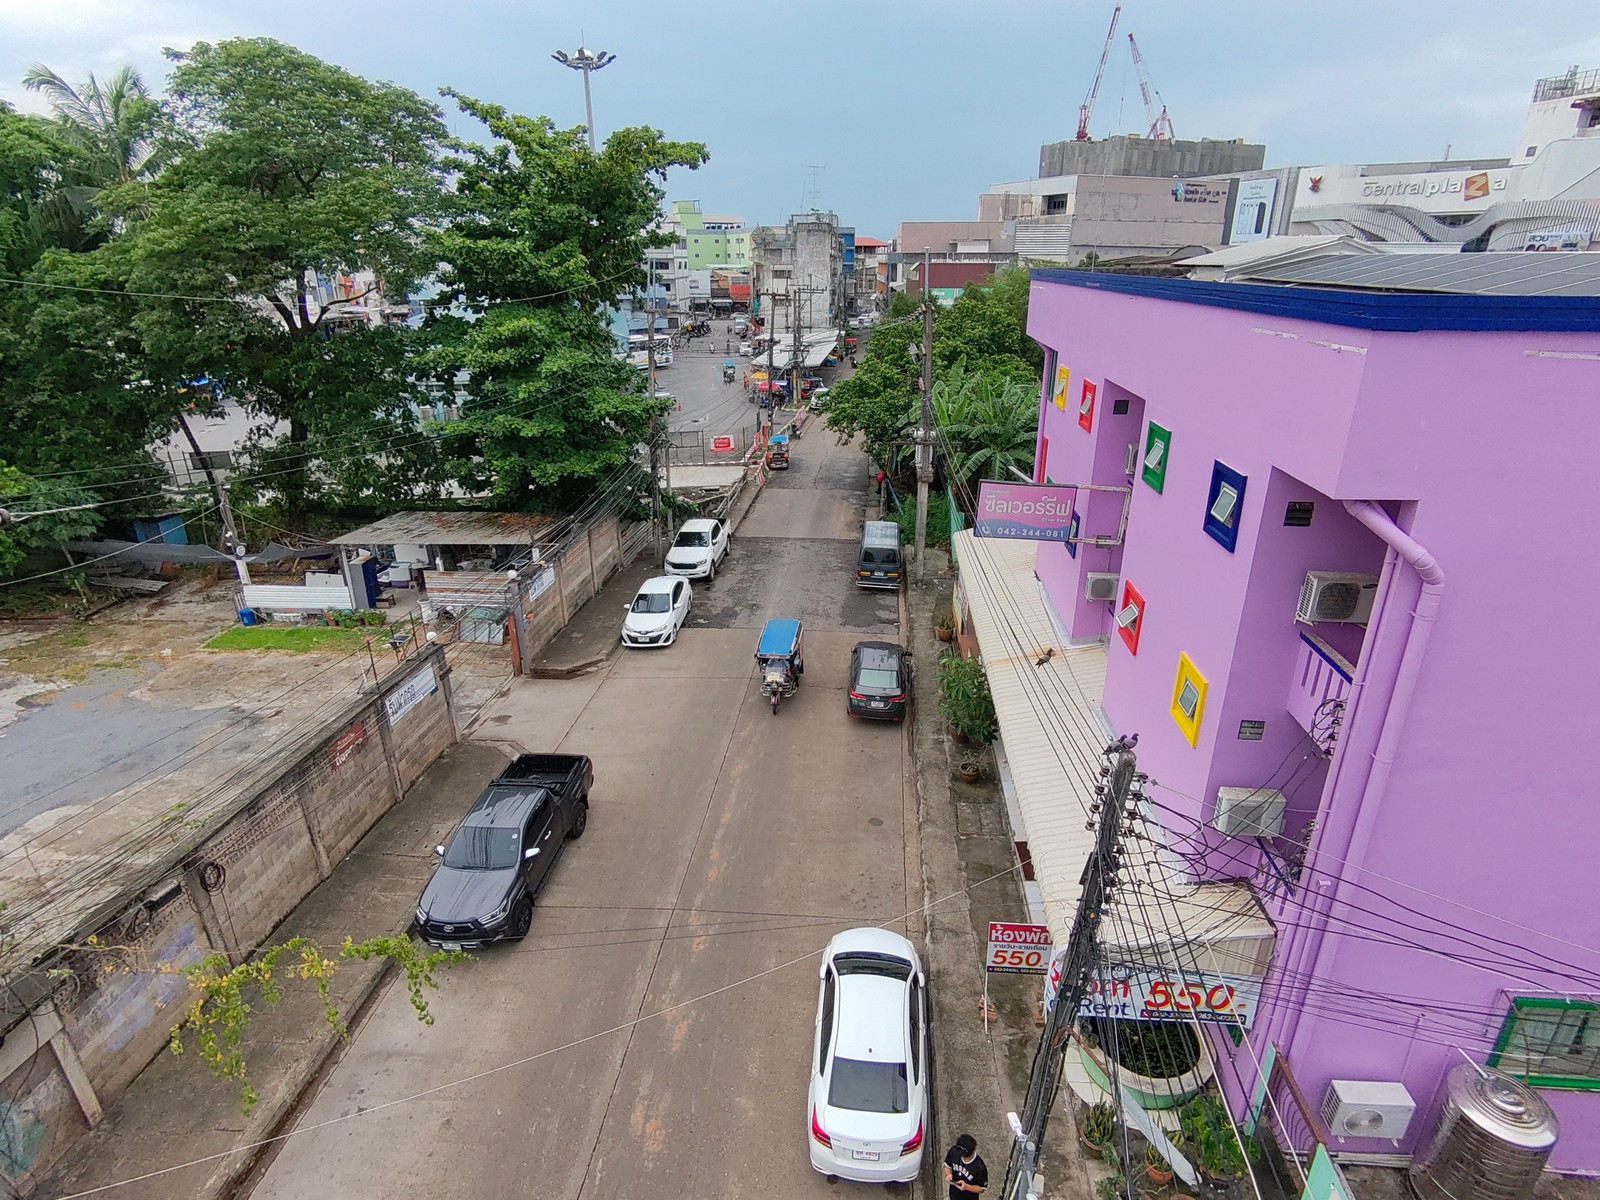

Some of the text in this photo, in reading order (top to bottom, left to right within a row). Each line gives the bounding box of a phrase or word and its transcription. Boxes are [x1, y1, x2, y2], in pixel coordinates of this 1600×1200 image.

[984, 495, 1071, 516] ซิลเวอร์รีฟ
[997, 527, 1064, 538] 042-344-081
[991, 924, 1051, 943] ห้องพัก
